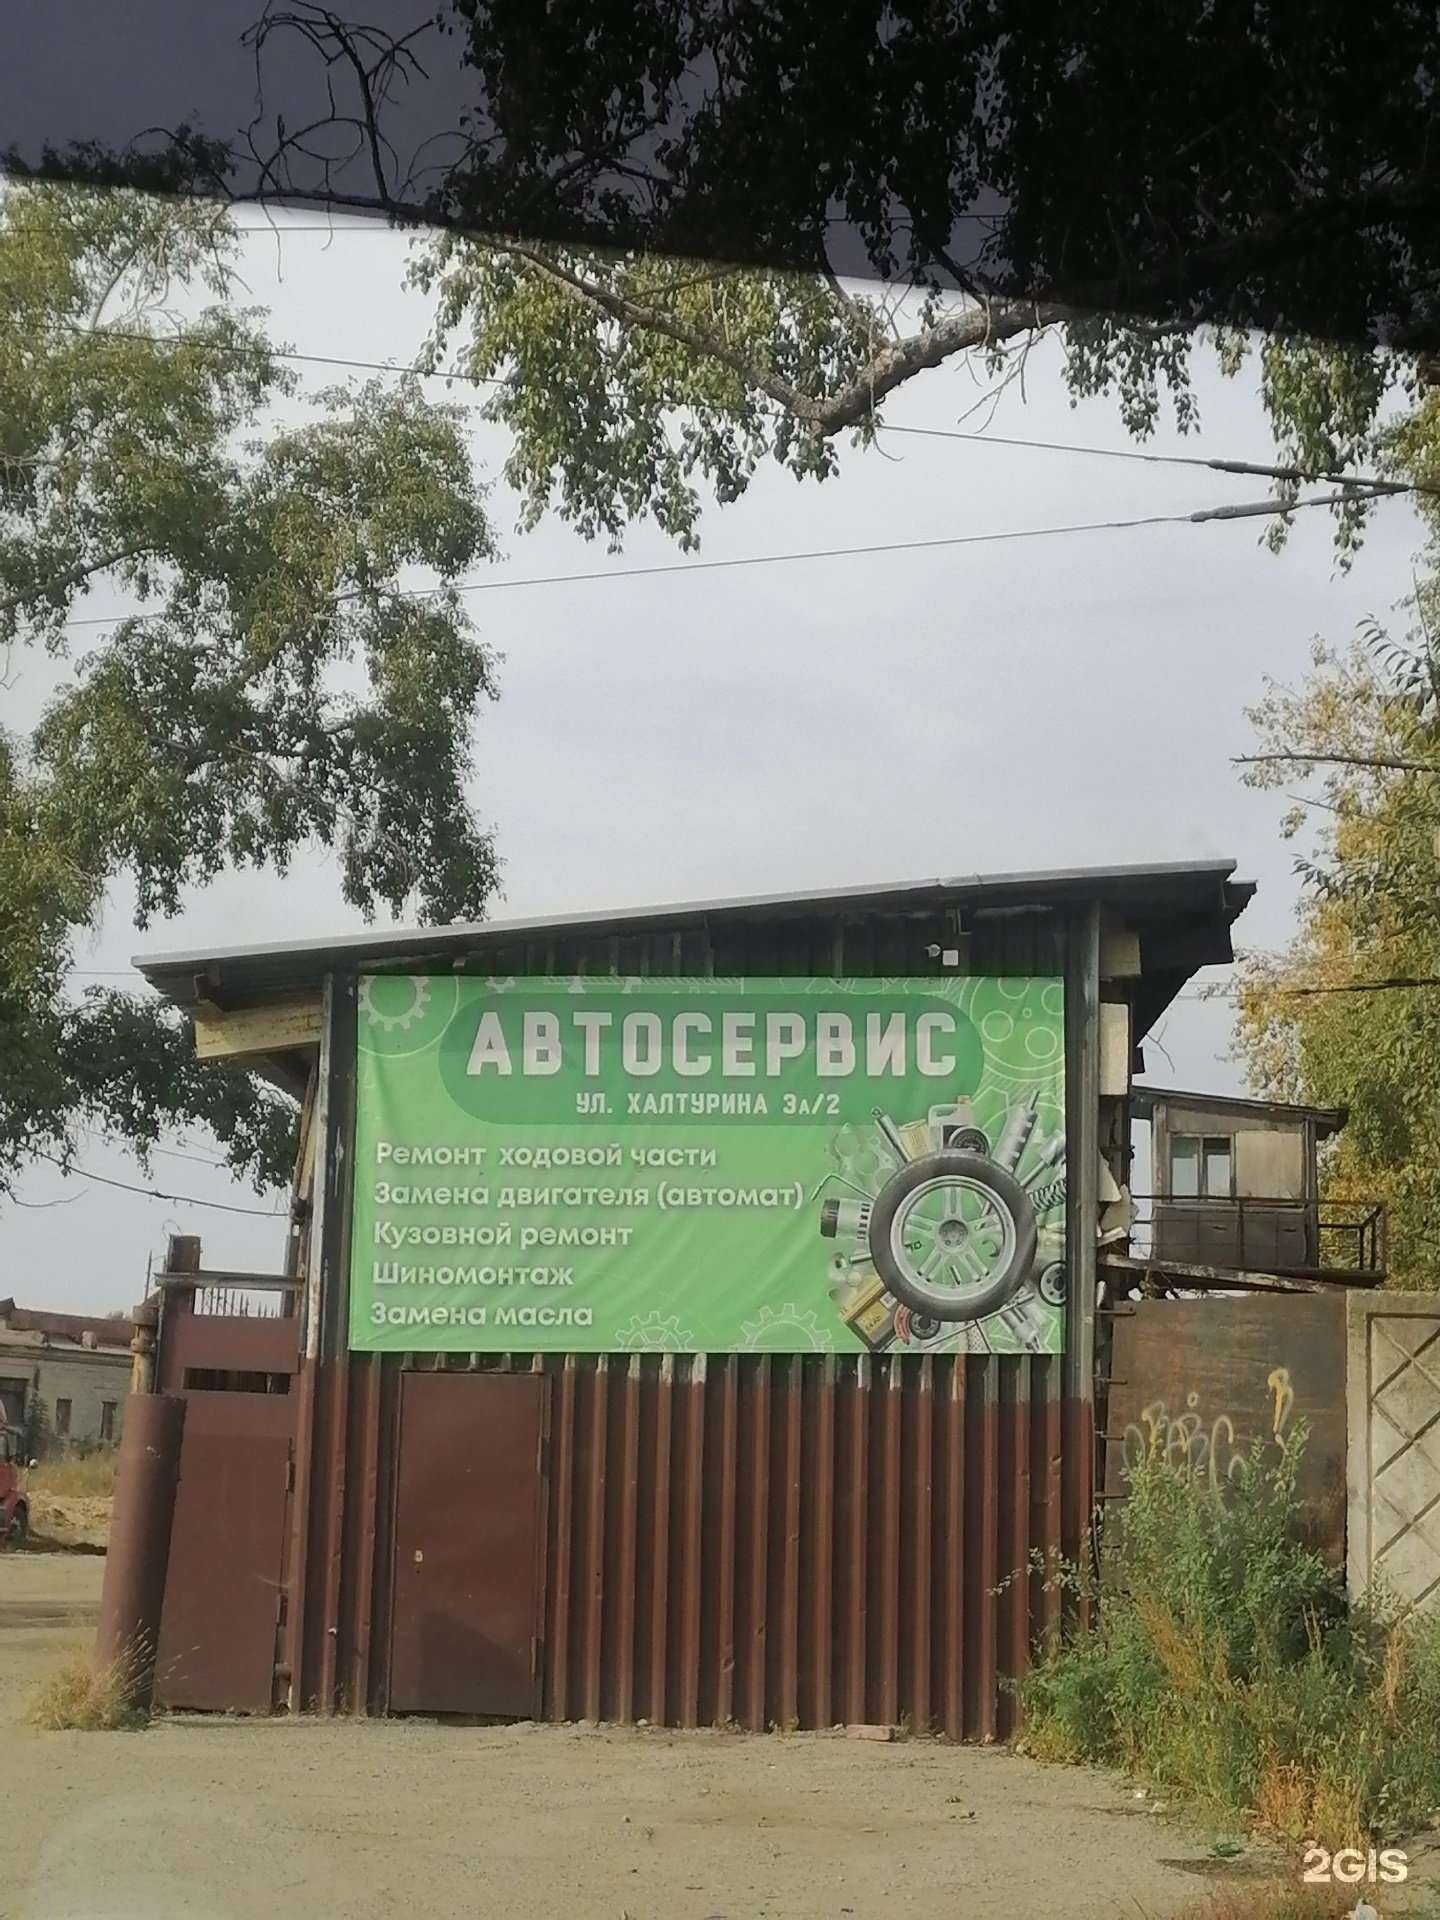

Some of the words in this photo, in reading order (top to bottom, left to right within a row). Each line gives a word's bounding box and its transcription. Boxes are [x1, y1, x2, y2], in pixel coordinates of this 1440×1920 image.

[466, 1011, 958, 1078] АВТОСЕРВИС
[576, 1093, 613, 1115] УЛ.
[628, 1092, 768, 1115] ХАЛТУРИНА
[376, 1142, 487, 1166] Ремонт
[499, 1142, 622, 1168] ходовой
[631, 1145, 717, 1168] части
[374, 1182, 489, 1205] Замена
[496, 1186, 650, 1208] двигателя
[656, 1182, 804, 1209] (автомат)
[373, 1221, 512, 1250] Кузовной
[520, 1224, 633, 1250] ремонт
[373, 1262, 574, 1286] Шиномонтаж
[371, 1301, 486, 1326] Замена
[494, 1303, 593, 1327] масла
